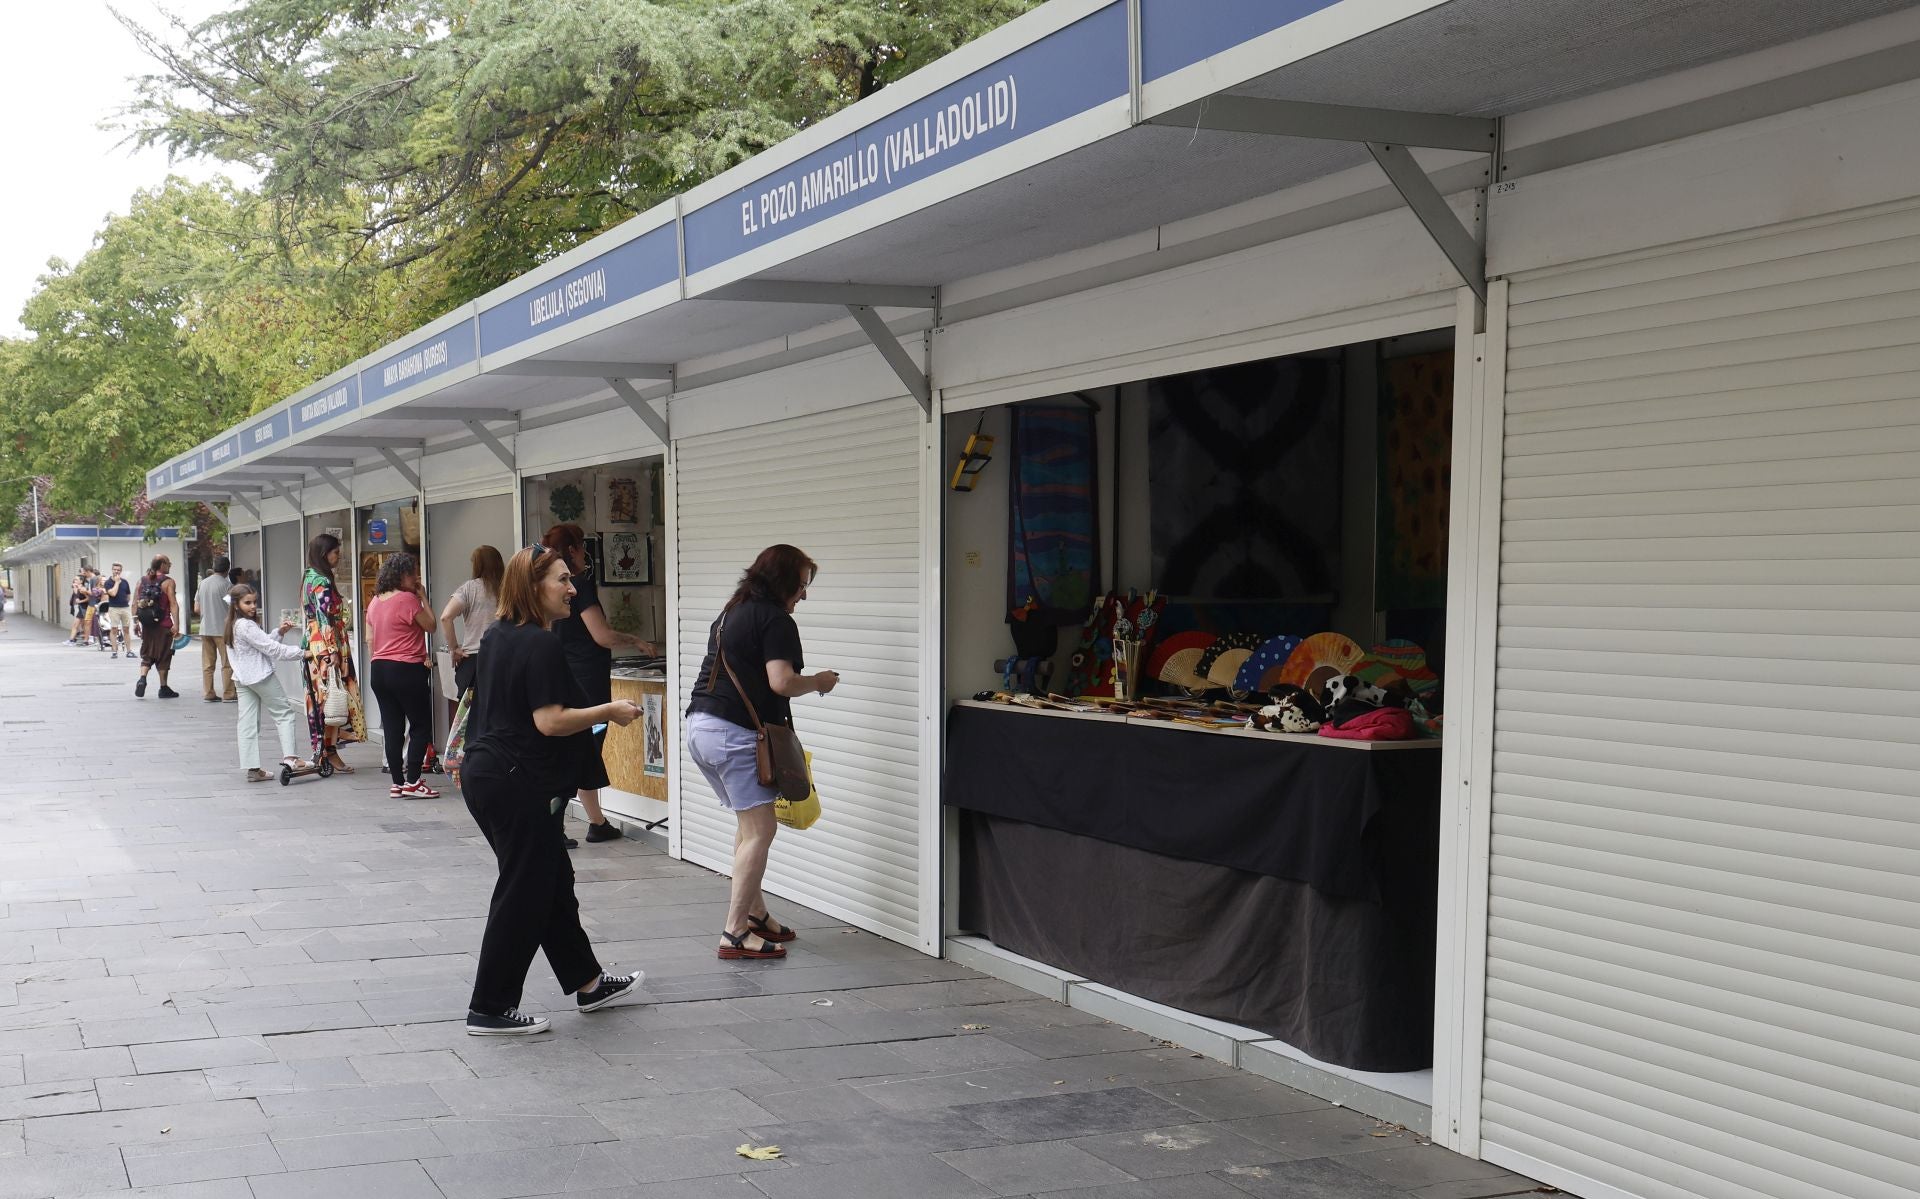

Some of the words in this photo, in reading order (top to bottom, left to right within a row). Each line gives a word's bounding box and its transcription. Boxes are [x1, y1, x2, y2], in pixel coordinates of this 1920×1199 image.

[742, 200, 758, 236] EL
[760, 181, 796, 229] POZO
[801, 143, 879, 213] AMARILLO
[884, 75, 1016, 185] (VALLADOLID)
[530, 289, 564, 326] LIBELULA
[566, 268, 605, 317] (SEGOVIA)
[423, 340, 447, 374] (BURGOS)
